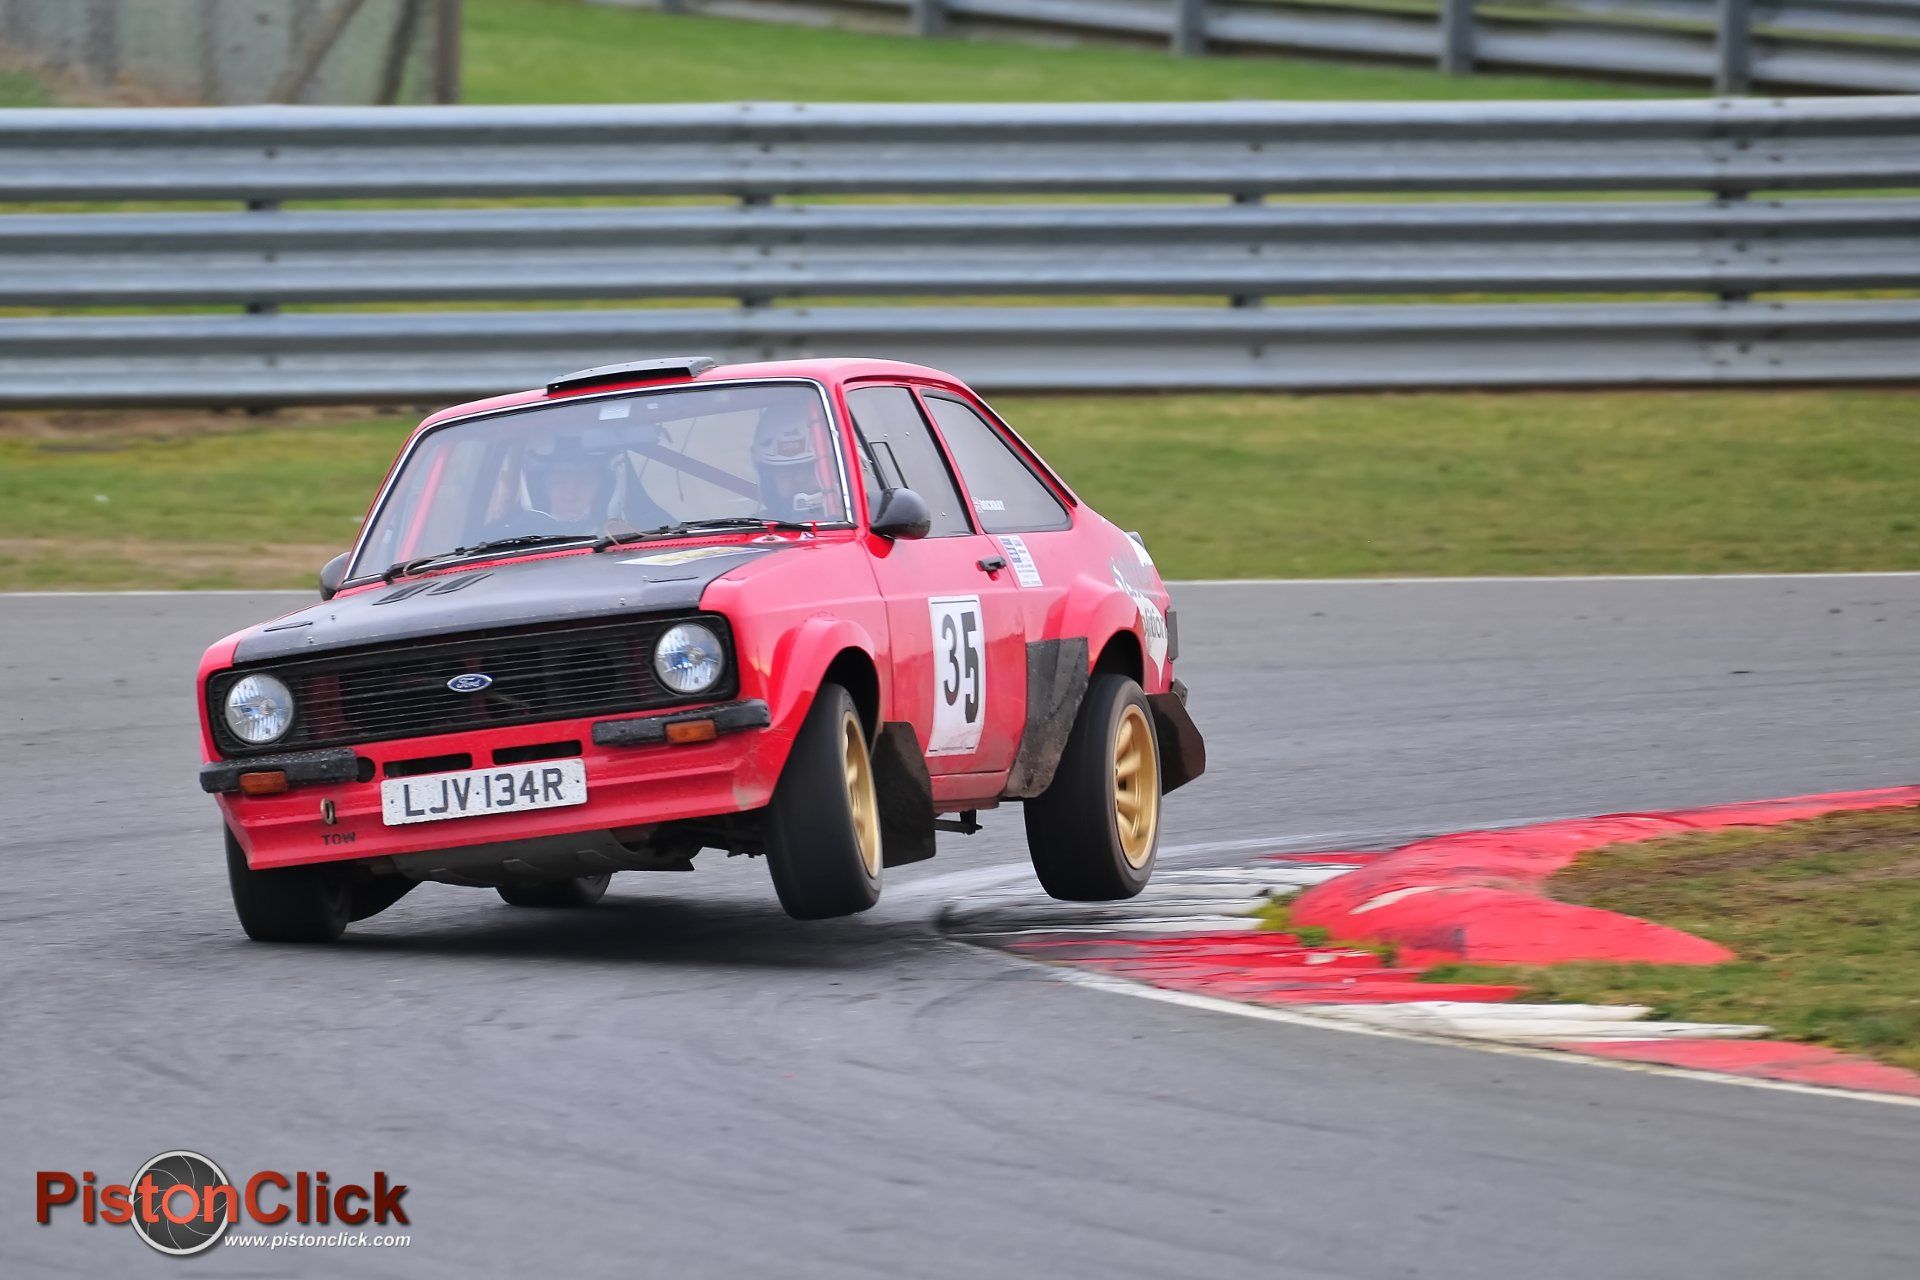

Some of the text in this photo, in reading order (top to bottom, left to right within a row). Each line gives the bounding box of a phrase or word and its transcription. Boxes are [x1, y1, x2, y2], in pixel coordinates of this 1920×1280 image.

[942, 611, 979, 724] 35
[403, 767, 564, 817] LJV 134R
[321, 831, 356, 846] TOW
